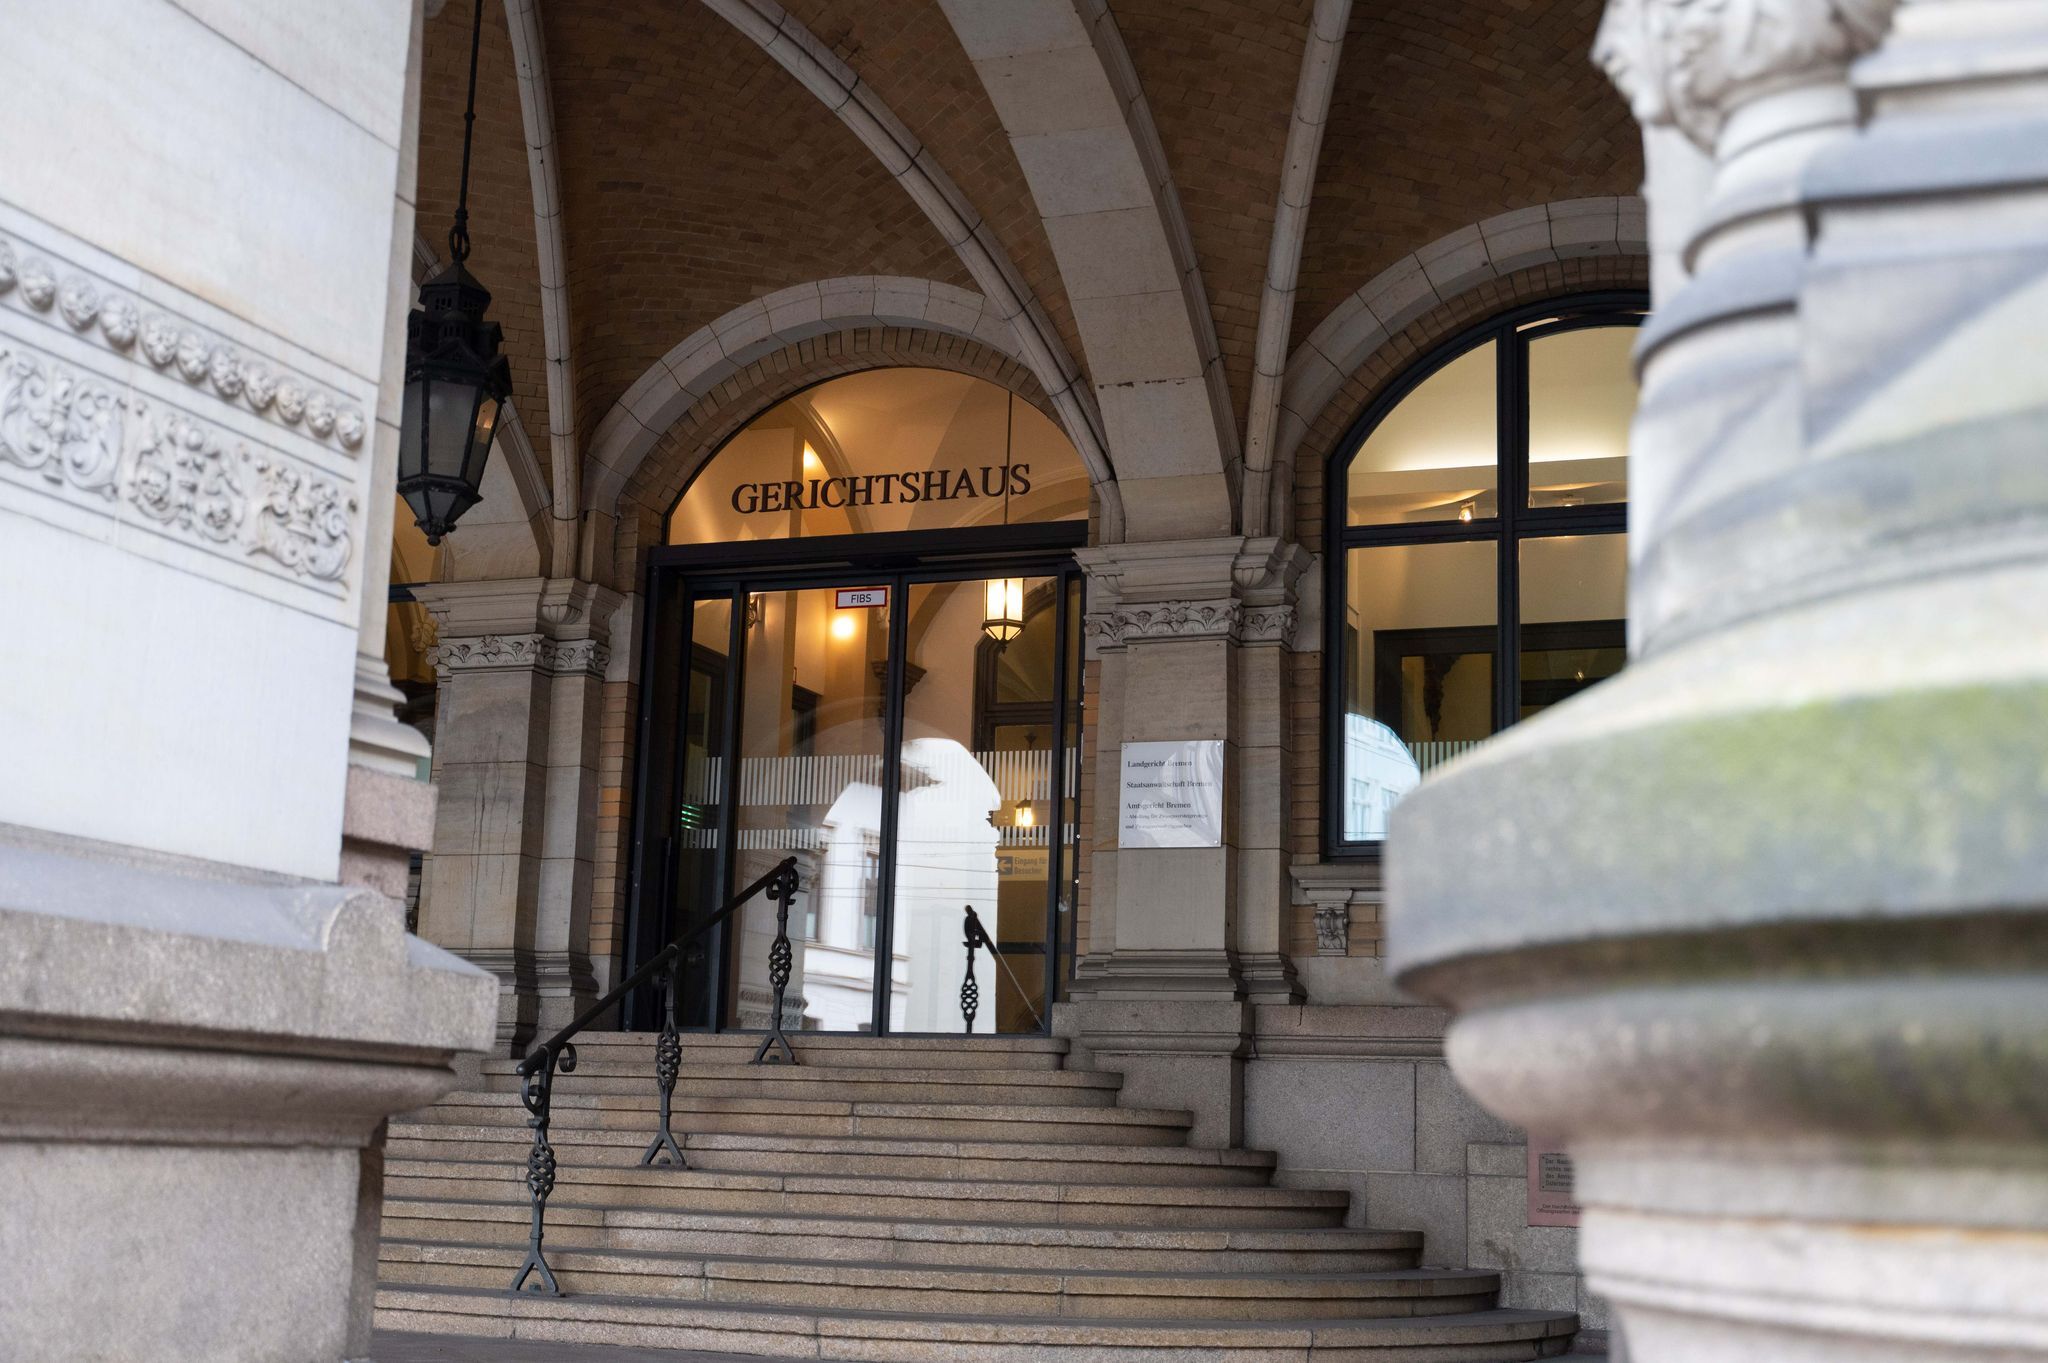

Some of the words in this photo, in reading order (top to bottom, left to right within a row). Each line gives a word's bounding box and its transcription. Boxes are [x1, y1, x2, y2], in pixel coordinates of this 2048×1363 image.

[731, 463, 1031, 514] GERICHTSHAUS
[850, 593, 872, 603] FIBS
[1127, 760, 1165, 769] Landgericht
[1126, 802, 1164, 810] Amtsgericht
